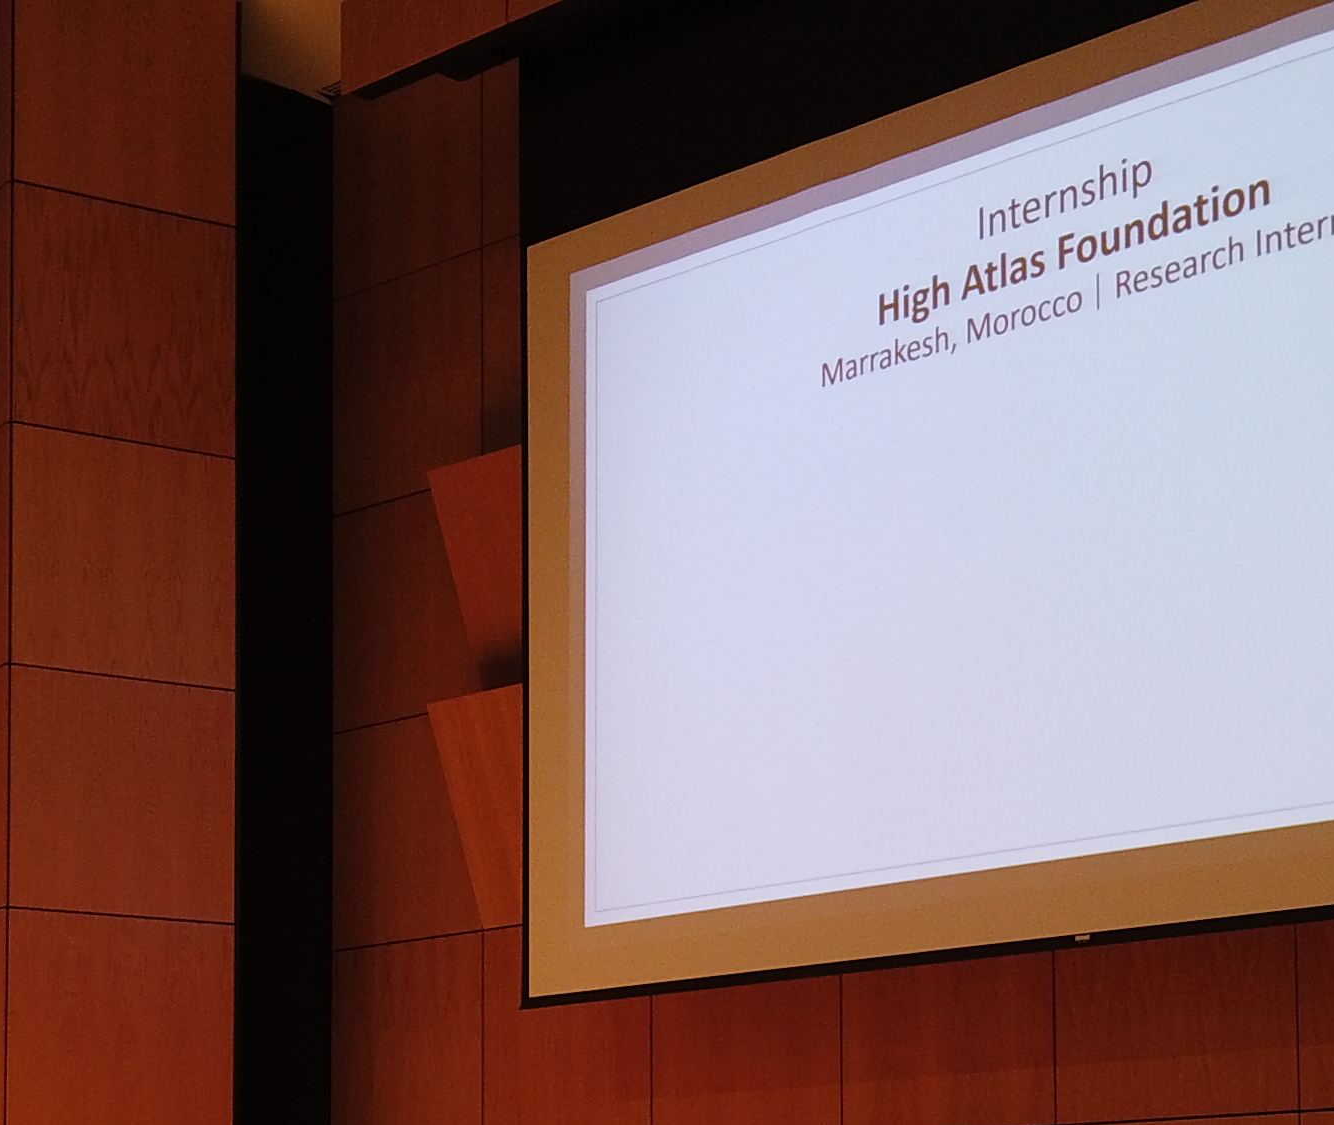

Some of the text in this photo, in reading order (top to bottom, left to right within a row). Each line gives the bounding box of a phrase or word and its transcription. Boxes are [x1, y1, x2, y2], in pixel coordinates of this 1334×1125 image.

[878, 178, 1271, 326] High Atlas Foundation
[978, 157, 1153, 240] Internship
[821, 326, 957, 388] Marrakesh,
[966, 291, 1083, 344] Morocco
[1115, 236, 1245, 299] Research
